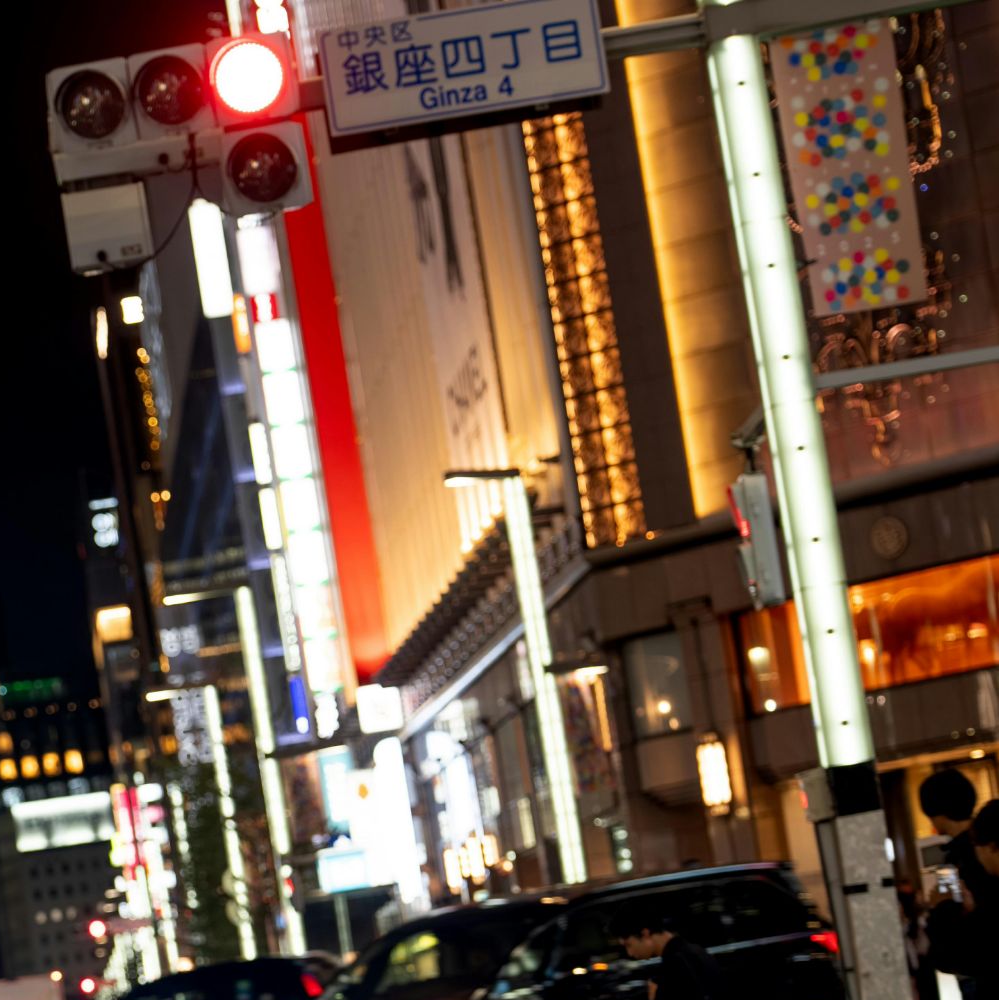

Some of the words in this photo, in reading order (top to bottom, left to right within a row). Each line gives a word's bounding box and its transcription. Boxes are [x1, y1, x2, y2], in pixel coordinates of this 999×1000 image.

[337, 20, 413, 50] 中央区
[343, 19, 583, 96] 銀座四丁目
[418, 81, 488, 110] Ginza
[498, 75, 515, 97] 4
